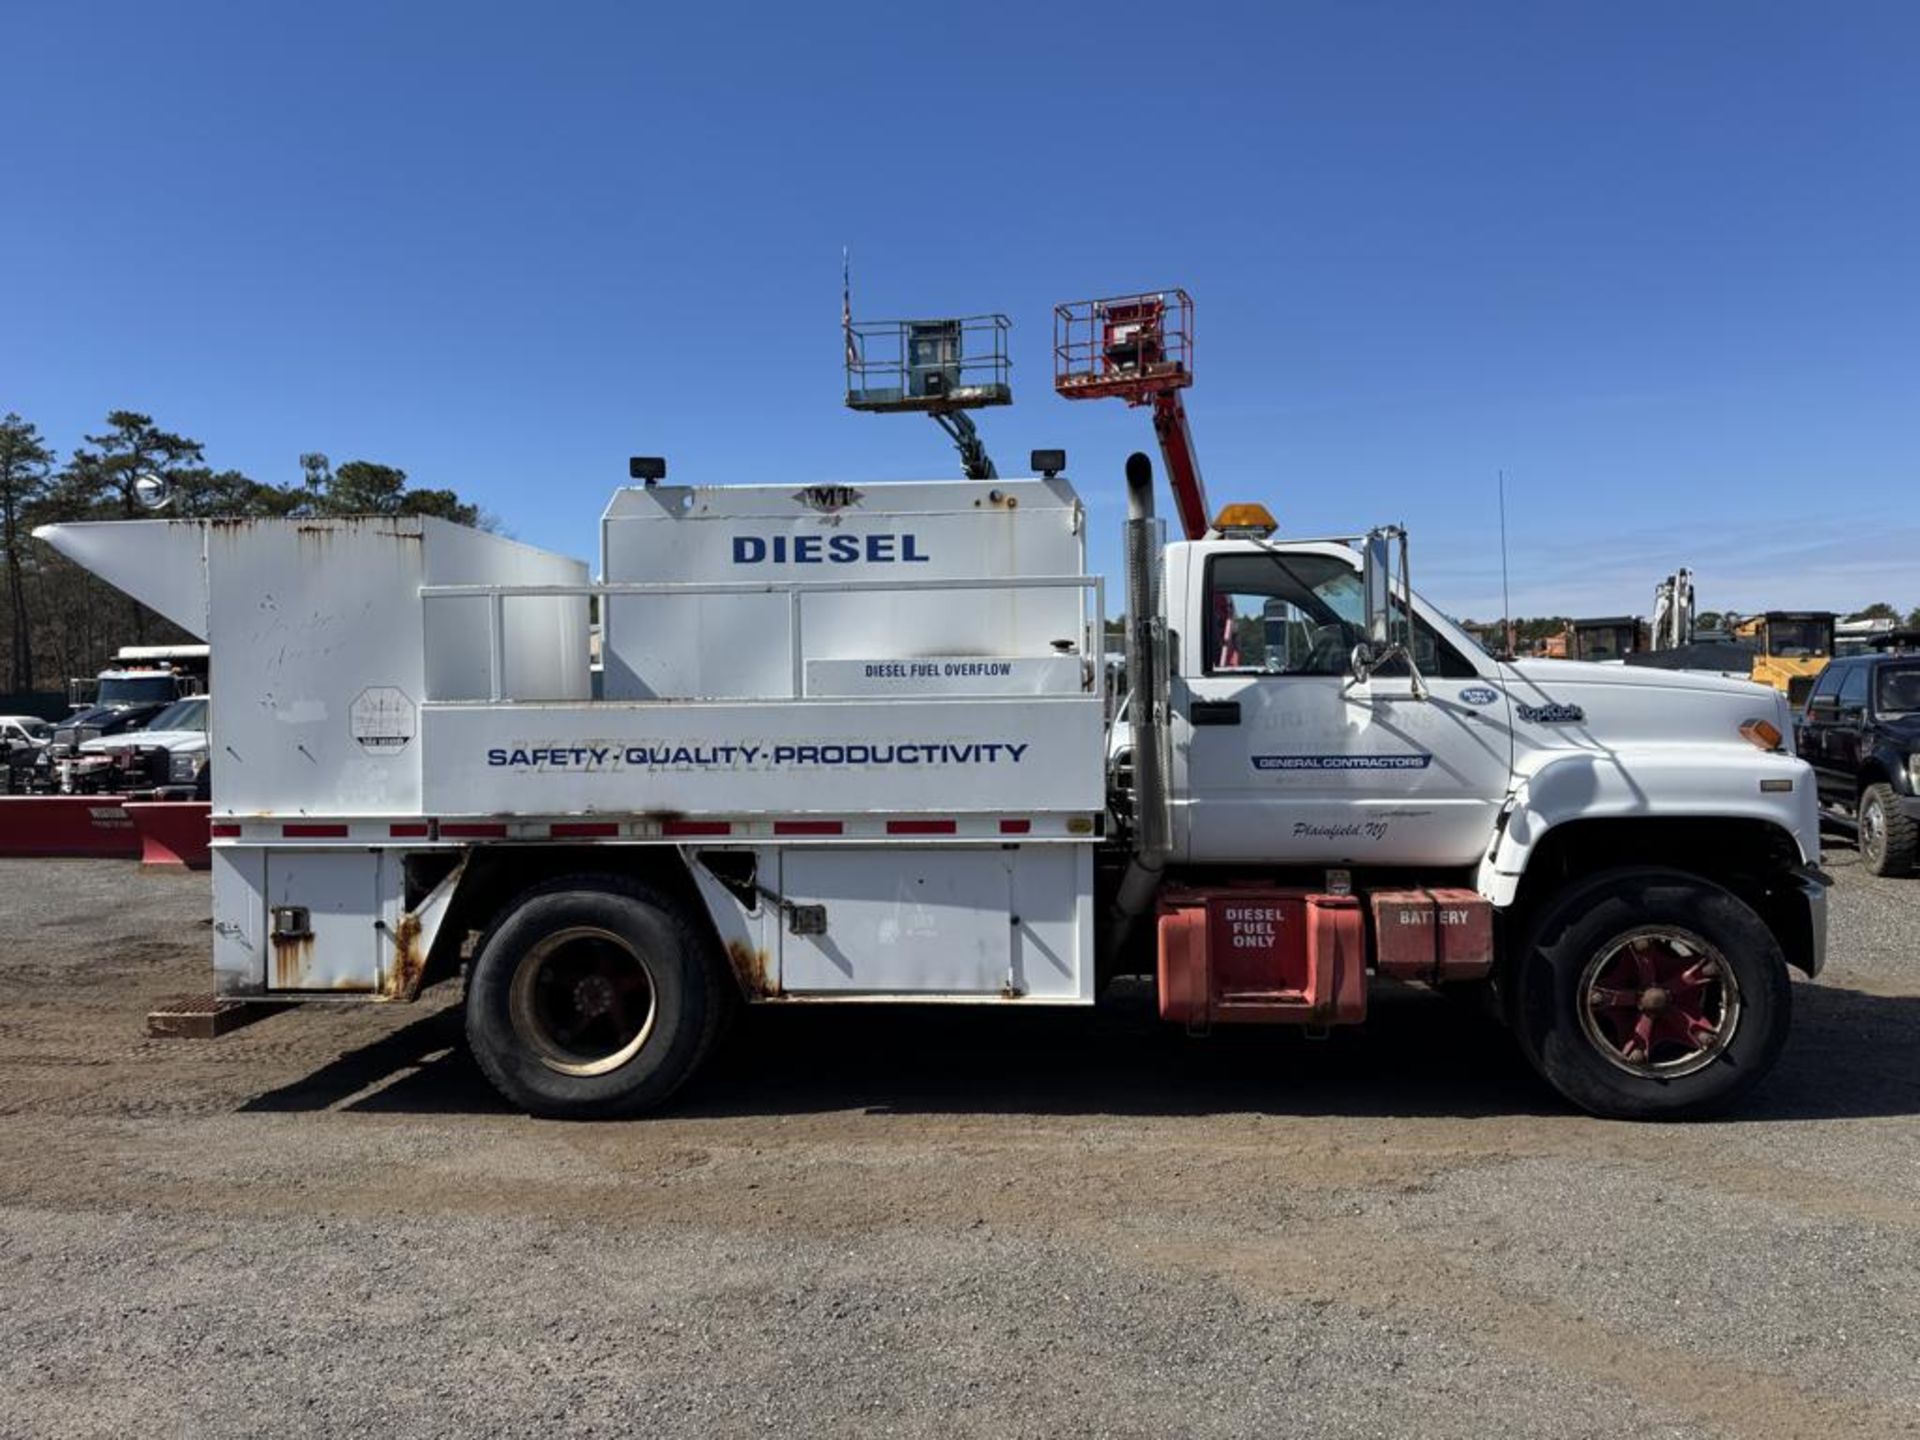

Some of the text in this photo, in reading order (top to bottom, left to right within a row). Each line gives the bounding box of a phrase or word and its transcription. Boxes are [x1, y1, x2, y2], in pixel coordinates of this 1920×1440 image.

[733, 534, 930, 563] DIESEL
[865, 663, 1012, 677] DIESEL FUEL OVERFLOW
[1259, 757, 1424, 768] GENERAL CONTRACTORS
[1365, 822, 1388, 841] NJ
[1226, 909, 1285, 920] DIESEL
[1233, 922, 1276, 934] FUEL
[1233, 935, 1276, 947] ONLY
